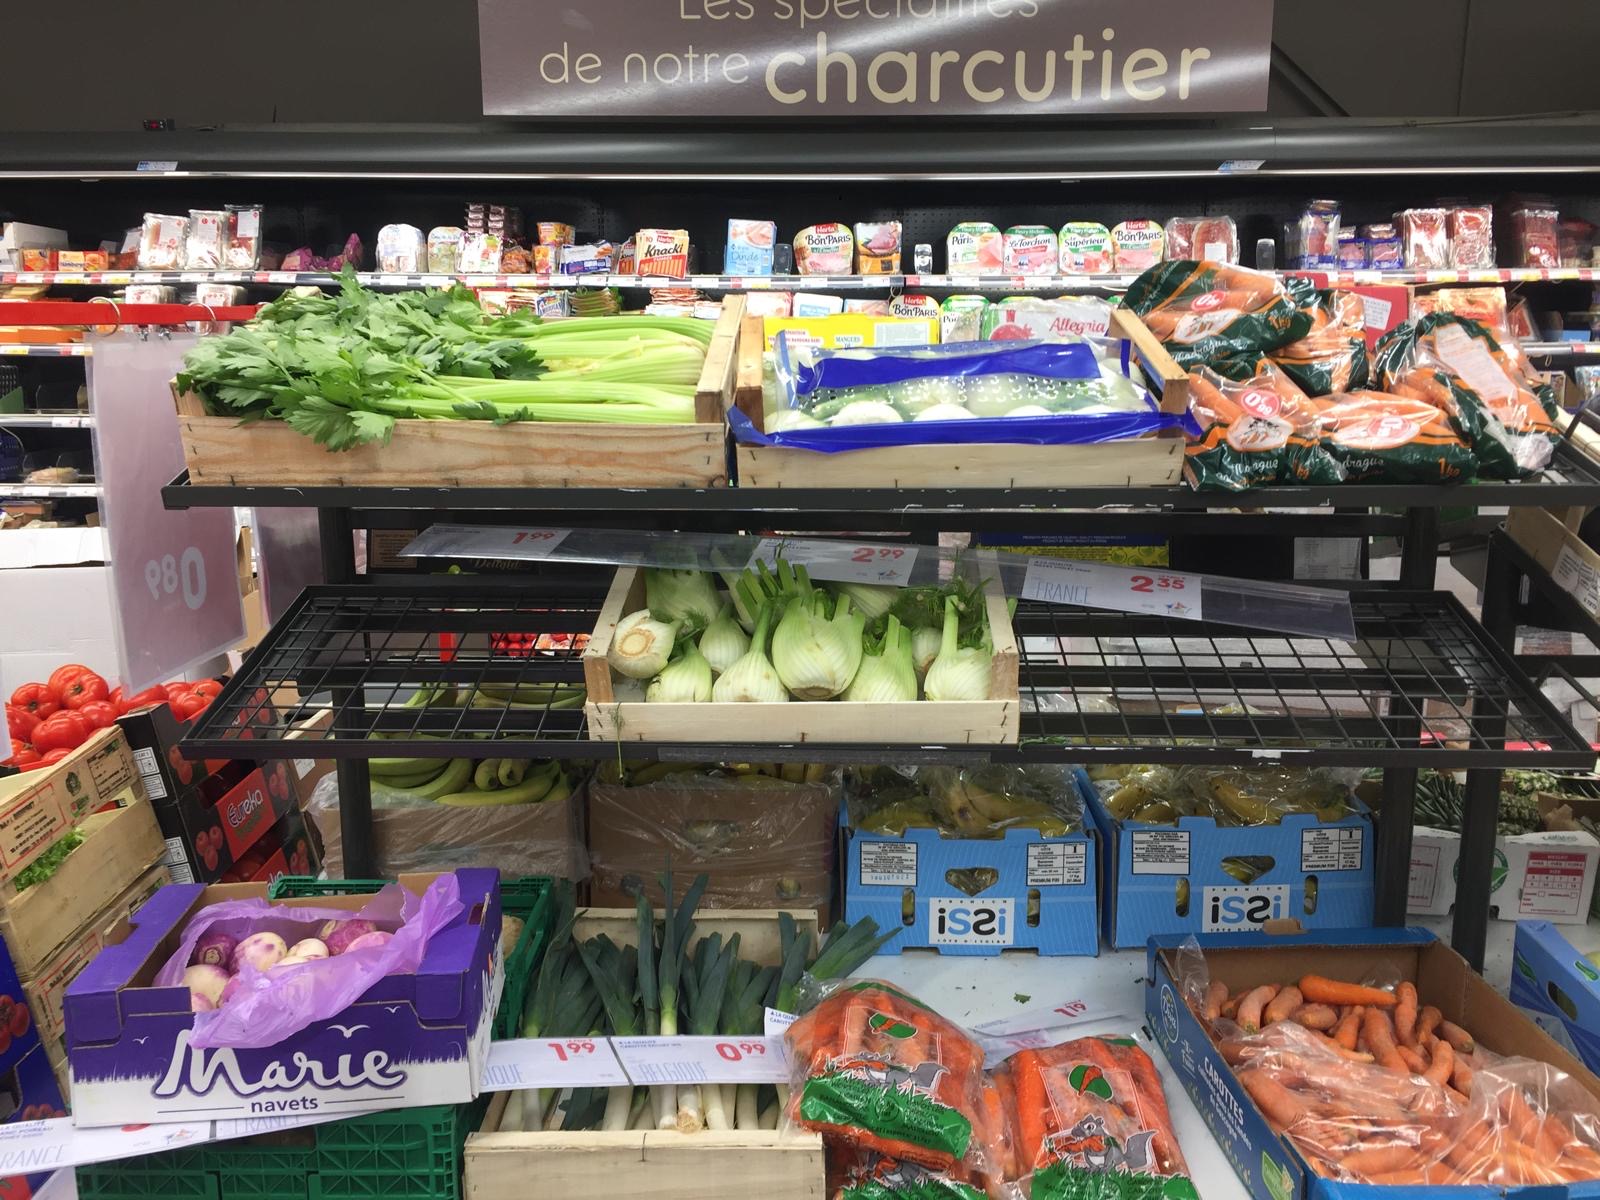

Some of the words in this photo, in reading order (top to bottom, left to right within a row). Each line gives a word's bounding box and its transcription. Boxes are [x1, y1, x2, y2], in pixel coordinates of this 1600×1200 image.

[540, 41, 602, 84] de
[624, 44, 749, 84] notre
[765, 31, 1211, 104] charcutier
[645, 243, 684, 257] Knacki
[1049, 317, 1105, 336] Allegria
[155, 1029, 407, 1097] Marie
[1204, 1057, 1245, 1125] CAROTTES
[251, 1096, 318, 1113] navets
[0, 1143, 67, 1169] RANCE
